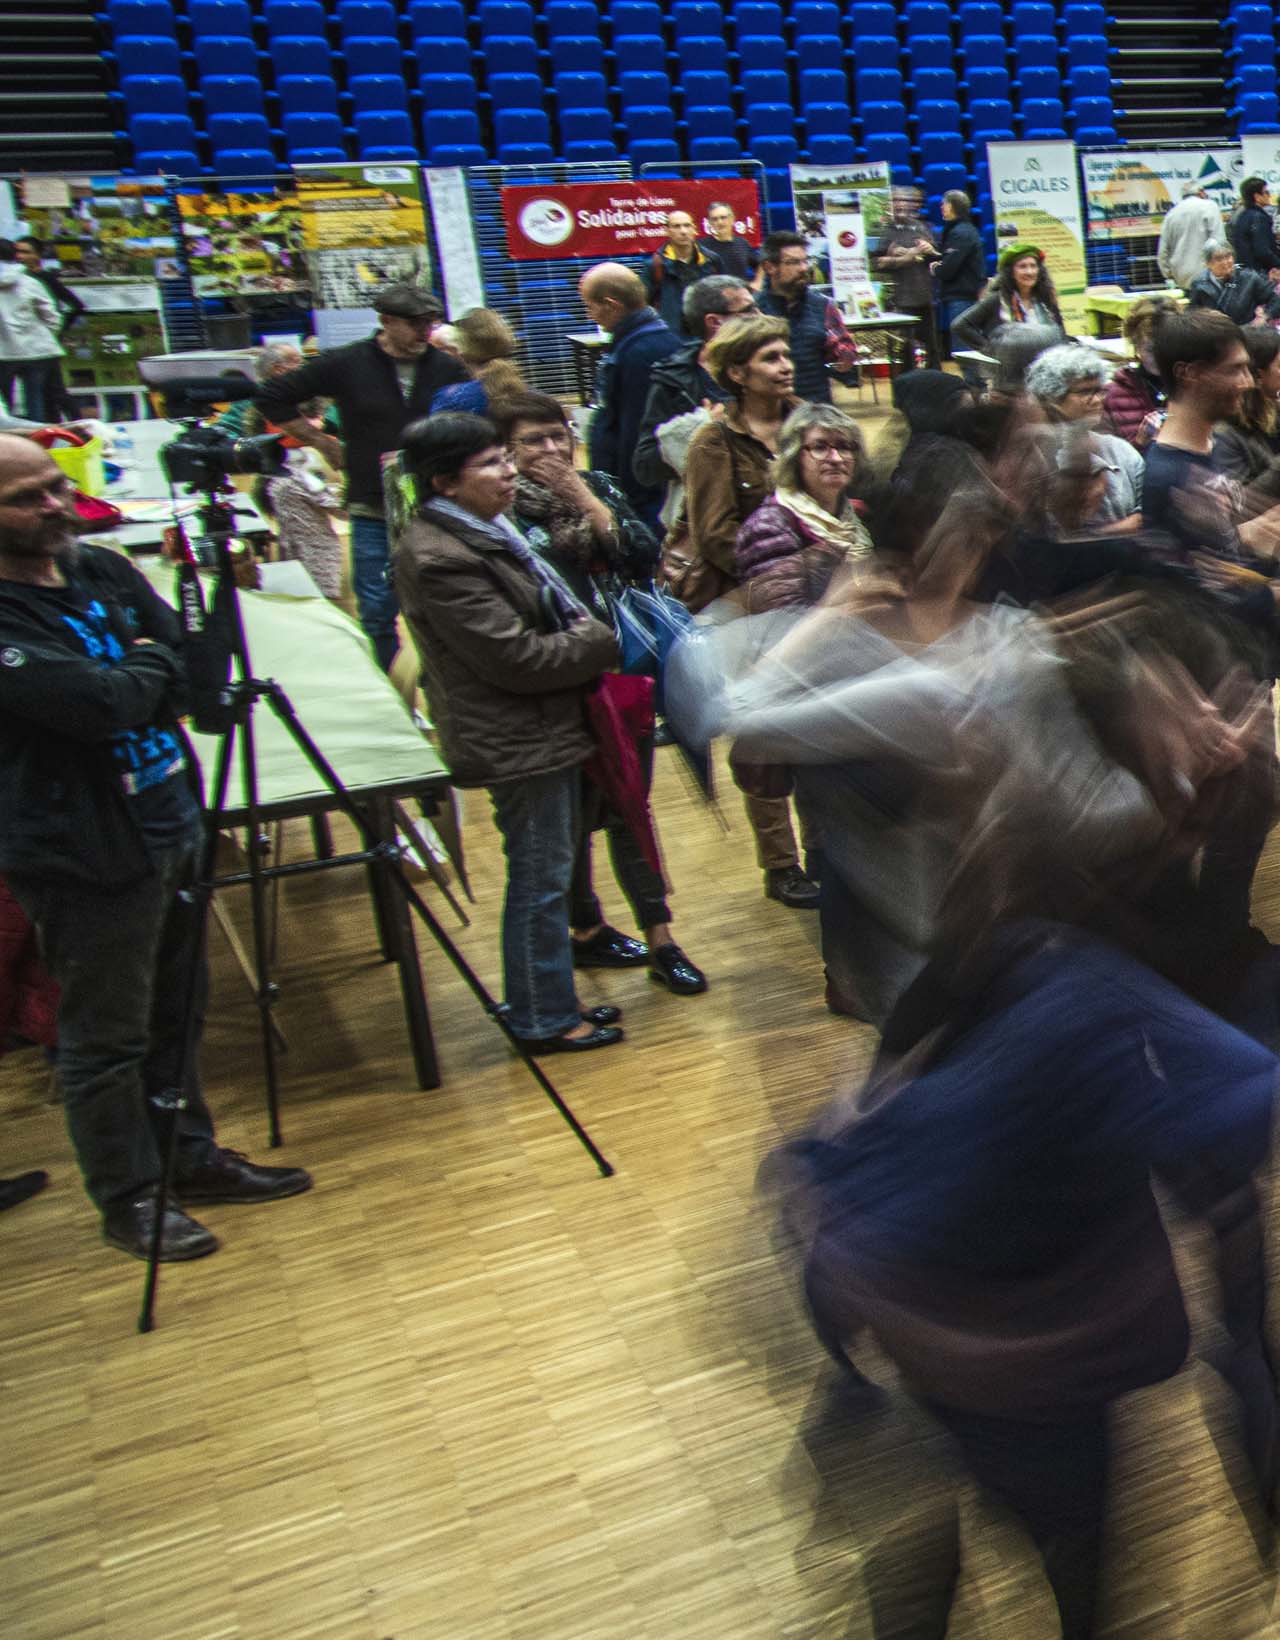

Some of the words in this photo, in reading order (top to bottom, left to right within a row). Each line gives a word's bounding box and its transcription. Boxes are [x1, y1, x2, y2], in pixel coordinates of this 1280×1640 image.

[1000, 177, 1071, 194] CIGALES
[637, 196, 649, 207] de
[577, 207, 668, 228] Solidaires
[182, 581, 204, 632] PENTAX
